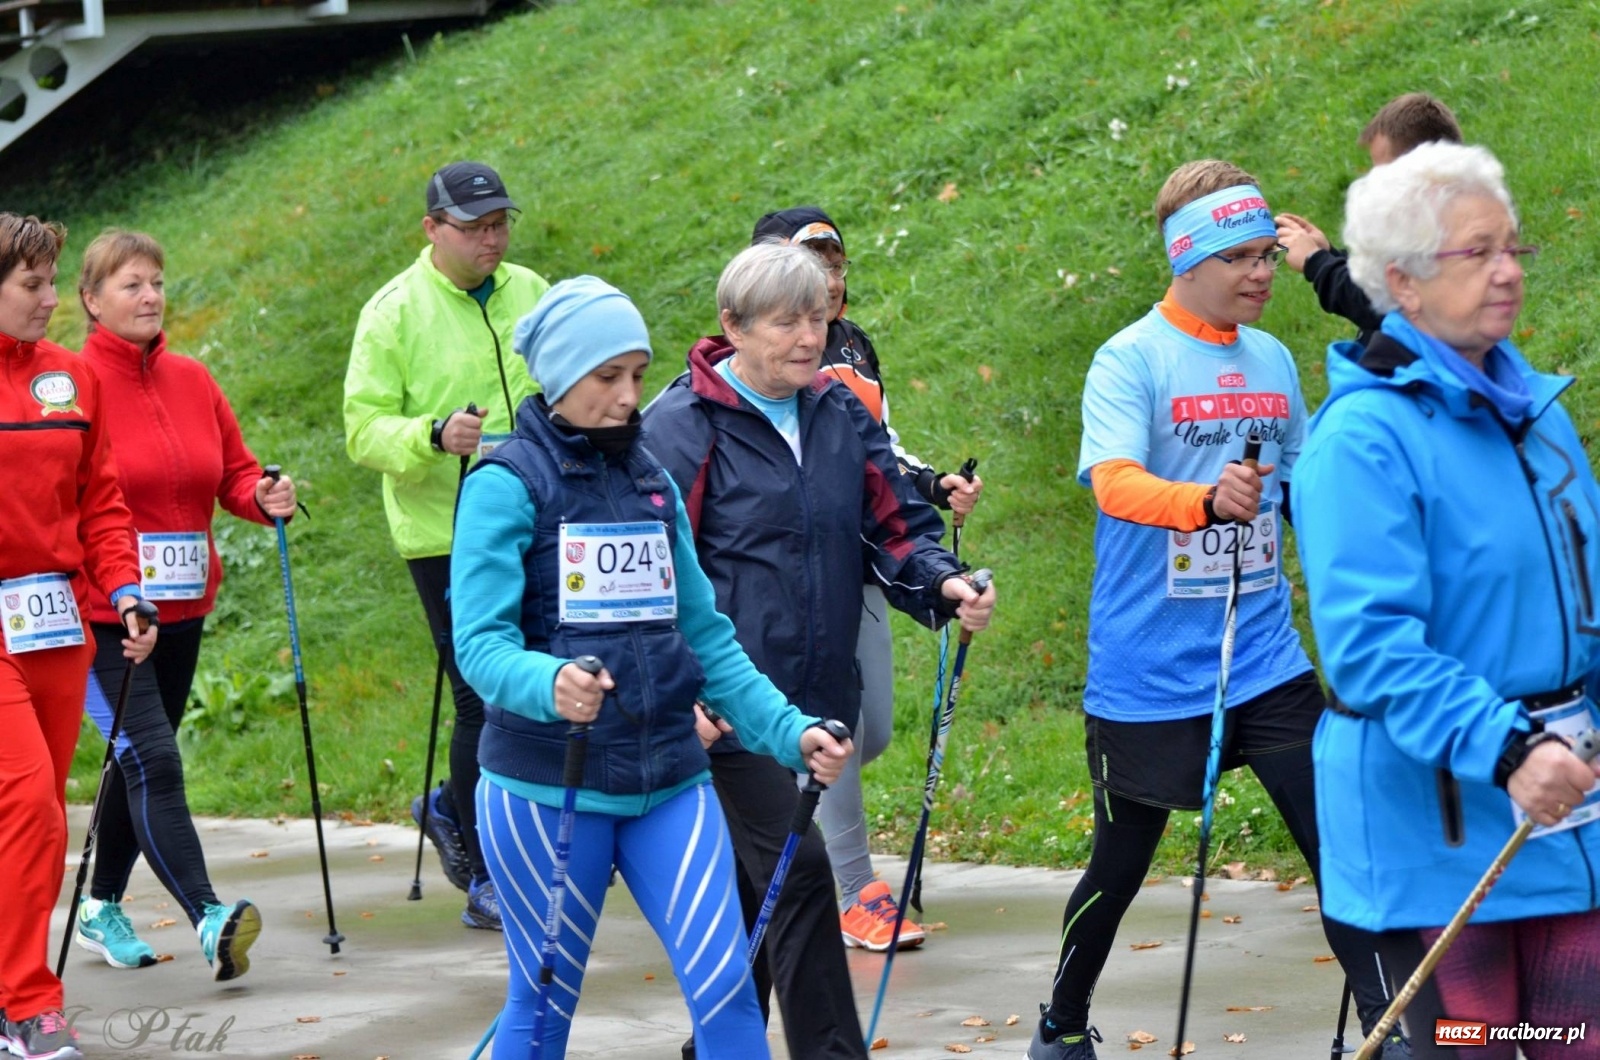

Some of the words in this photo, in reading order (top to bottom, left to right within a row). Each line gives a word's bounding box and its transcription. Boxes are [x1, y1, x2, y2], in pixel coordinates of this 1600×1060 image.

[1216, 211, 1256, 230] Nordic
[1219, 375, 1245, 387] HERO
[1180, 401, 1189, 418] I
[1222, 397, 1288, 415] LOVE
[1174, 417, 1232, 448] Nordic
[1202, 521, 1256, 556] 022
[163, 545, 199, 567] 014
[597, 541, 653, 574] 024
[28, 590, 68, 617] 013
